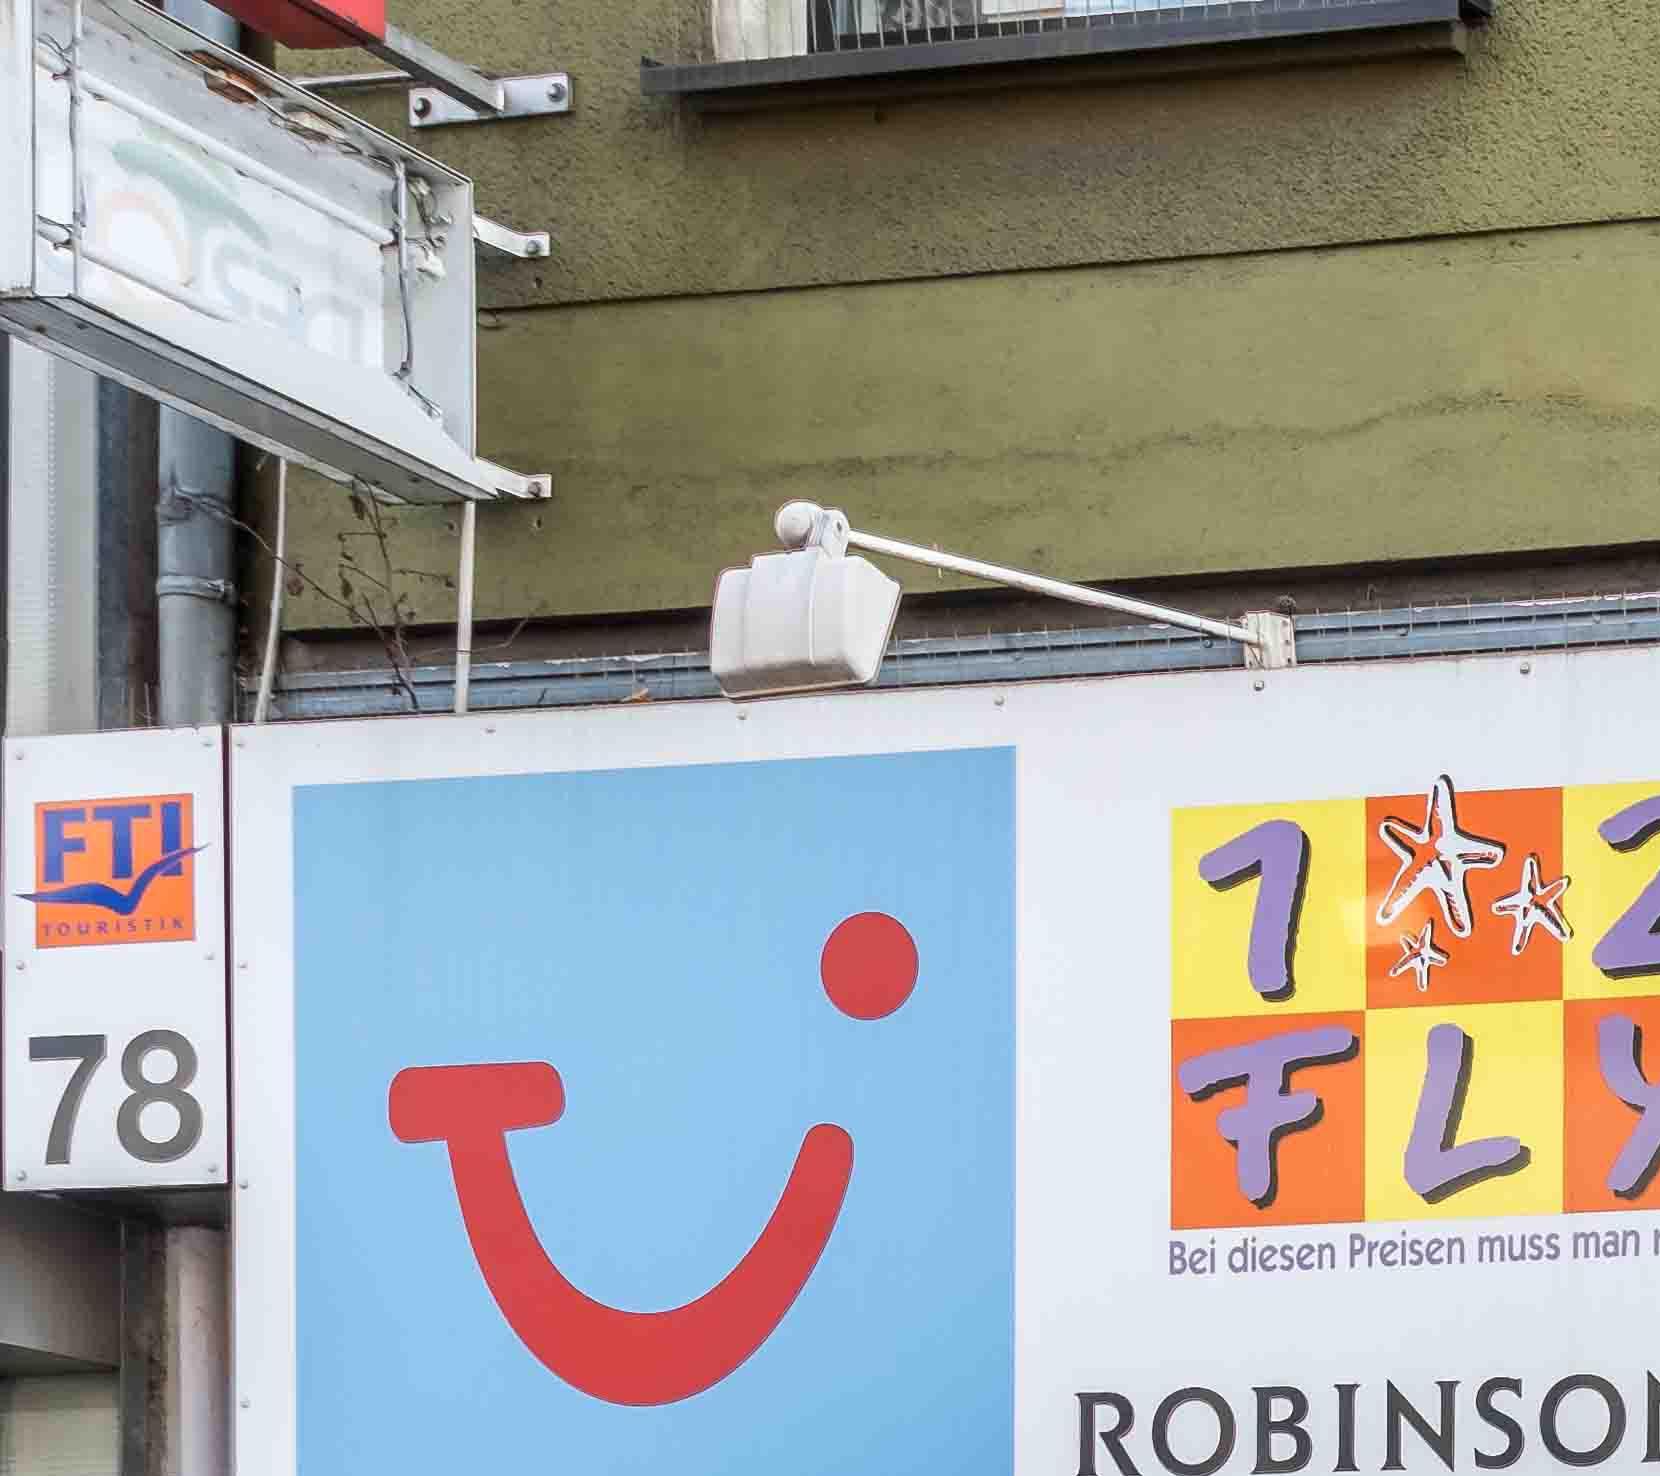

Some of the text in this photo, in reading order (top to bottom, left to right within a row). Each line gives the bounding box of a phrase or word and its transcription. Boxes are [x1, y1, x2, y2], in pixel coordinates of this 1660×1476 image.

[43, 803, 184, 884] FTI
[41, 915, 186, 938] TOURISTIK
[28, 1028, 205, 1165] 78
[1168, 1239, 1216, 1277] Bei
[1226, 1239, 1336, 1275] diesen
[1348, 1231, 1467, 1270] Preisen
[1477, 1234, 1561, 1265] muss
[1571, 1231, 1641, 1262] man
